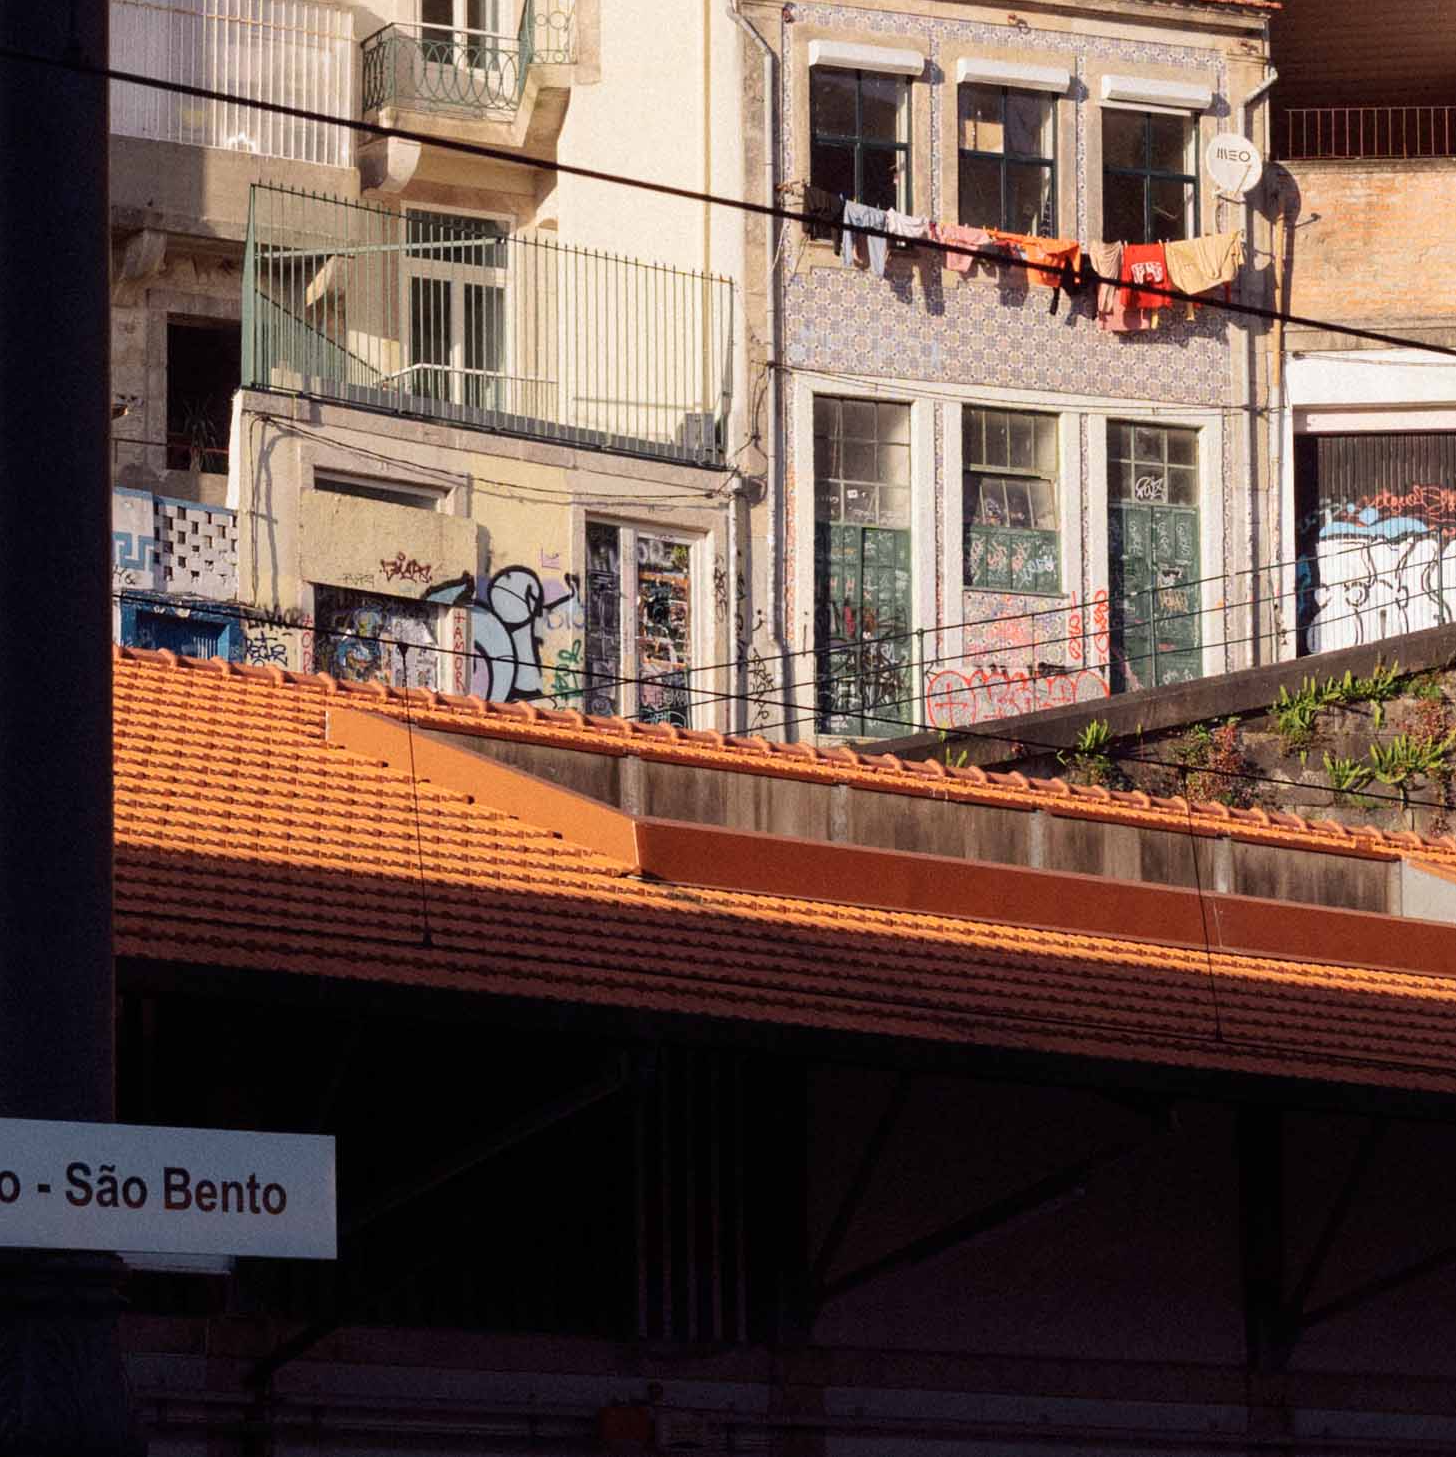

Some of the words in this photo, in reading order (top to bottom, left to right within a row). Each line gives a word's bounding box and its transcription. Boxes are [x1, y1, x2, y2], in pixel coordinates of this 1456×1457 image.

[1217, 147, 1251, 162] MEO
[65, 1162, 148, 1209] São
[163, 1166, 287, 1215] Bento
